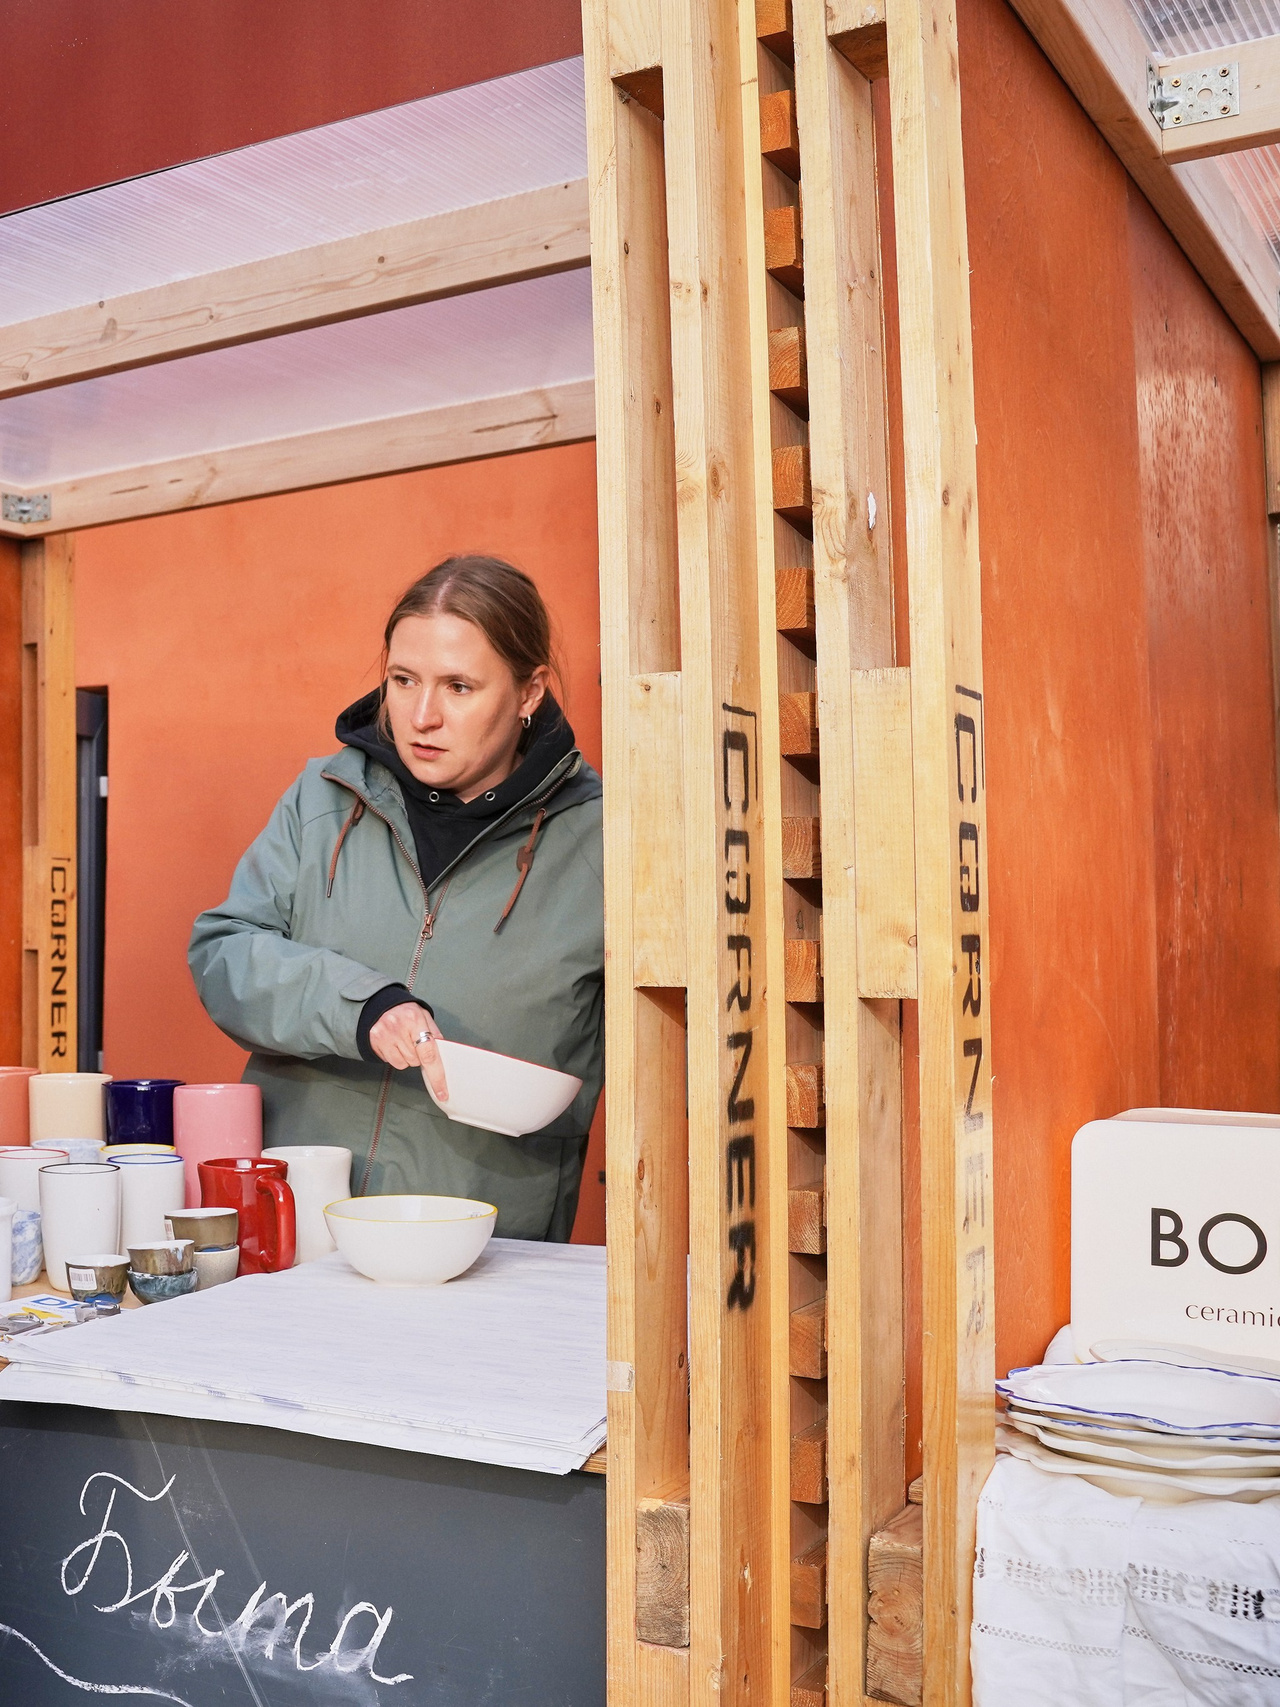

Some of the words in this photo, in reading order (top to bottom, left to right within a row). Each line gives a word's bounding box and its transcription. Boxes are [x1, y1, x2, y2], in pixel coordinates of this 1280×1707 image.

[50, 866, 68, 1058] CORNER
[721, 729, 757, 1312] CORNER
[955, 713, 987, 1337] CORNER
[1150, 1207, 1268, 1275] BO
[1184, 1303, 1280, 1328] cerami
[60, 1471, 415, 1685] Быта
